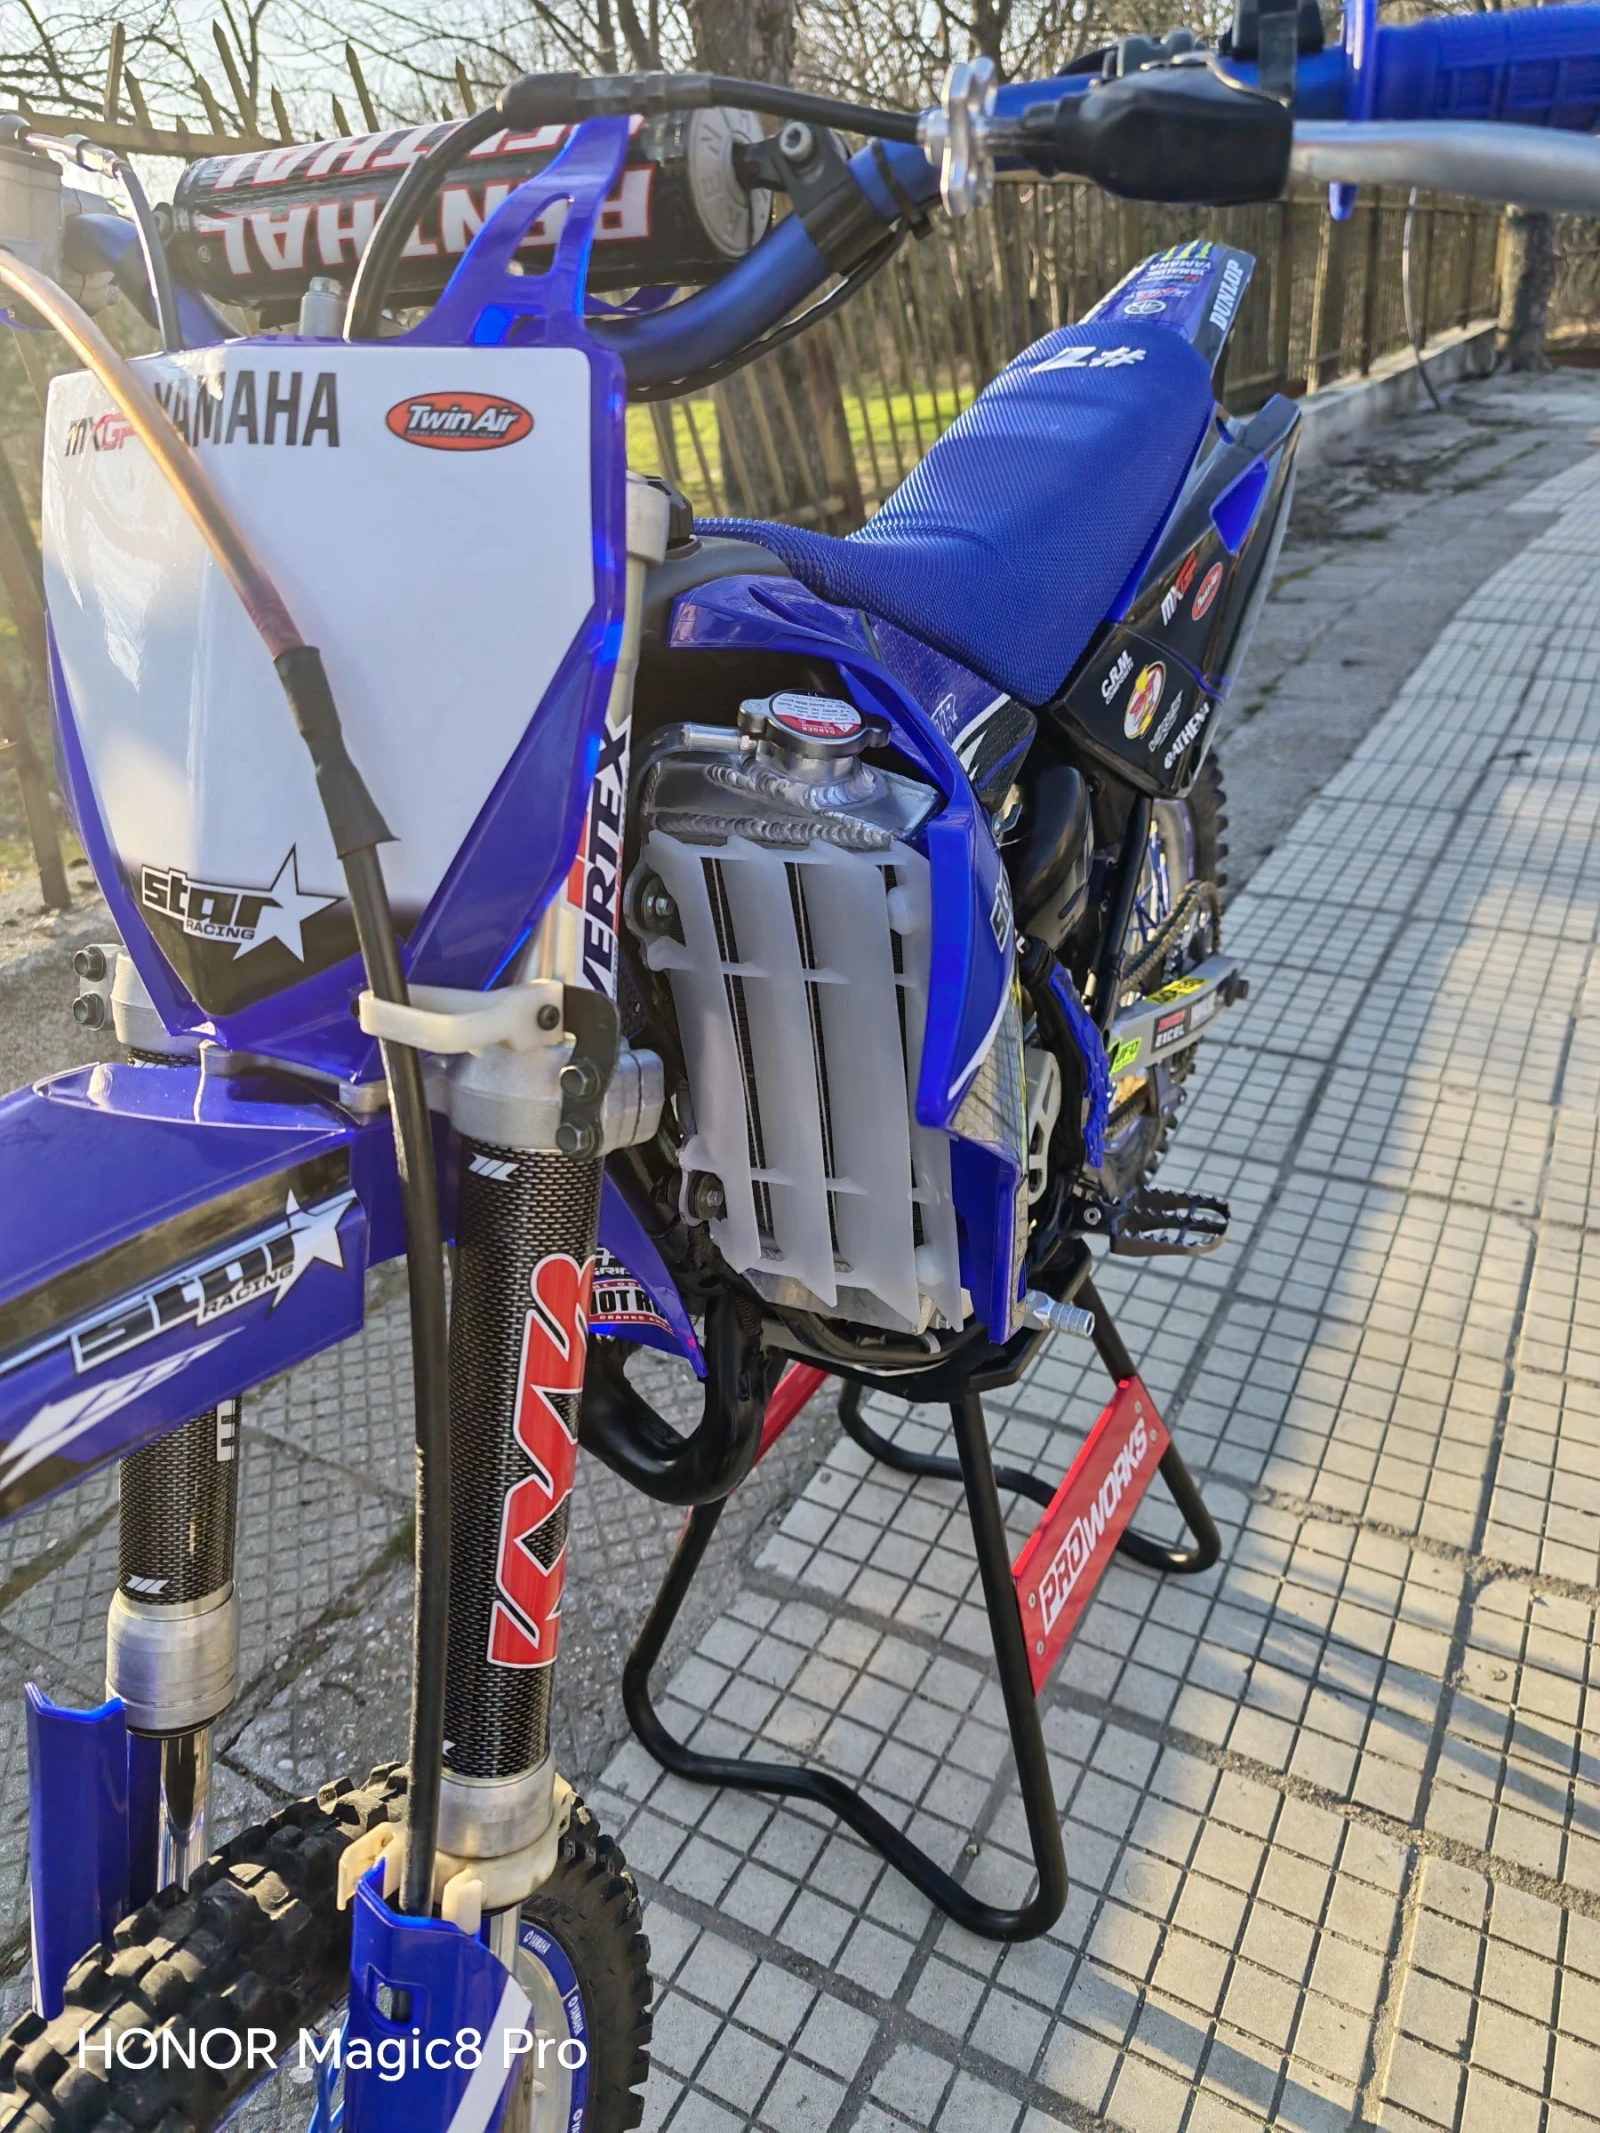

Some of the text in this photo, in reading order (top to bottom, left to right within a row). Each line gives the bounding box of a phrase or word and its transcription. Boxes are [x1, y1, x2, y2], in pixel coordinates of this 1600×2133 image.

[1209, 259, 1244, 331] DUNLOP
[408, 404, 519, 432] Twin Air
[186, 918, 256, 941] RACING
[203, 1262, 295, 1318] RACING
